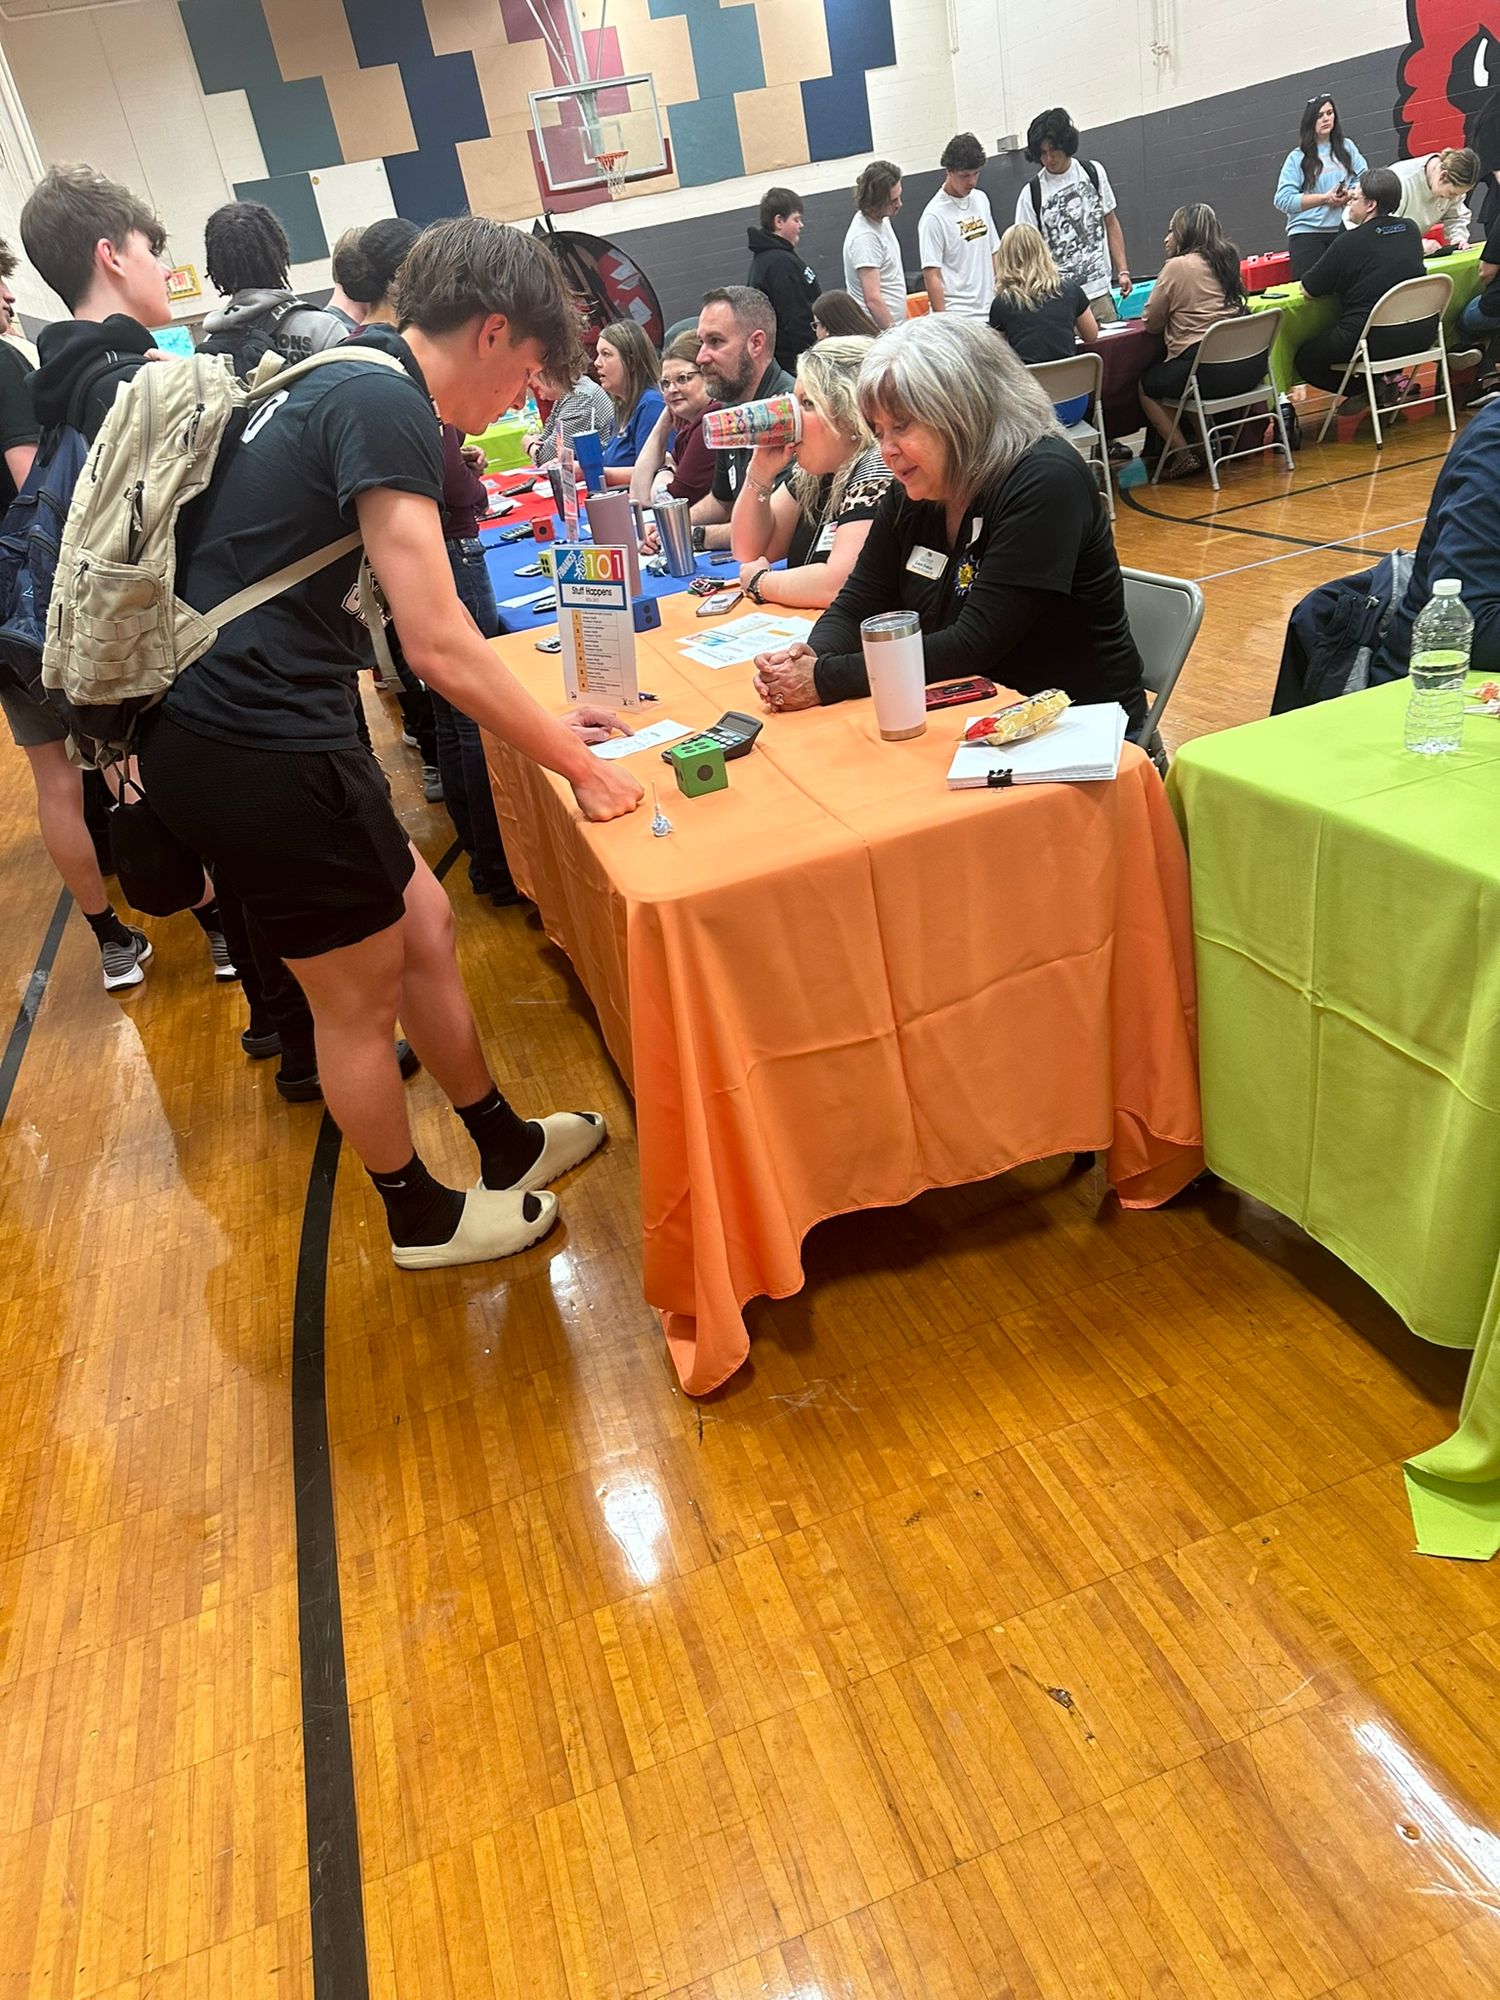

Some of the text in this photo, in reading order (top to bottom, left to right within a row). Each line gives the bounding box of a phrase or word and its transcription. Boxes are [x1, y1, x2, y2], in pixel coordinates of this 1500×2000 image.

[278, 333, 312, 351] ONS
[587, 553, 622, 579] 101
[571, 586, 613, 597] Stuff Happens
